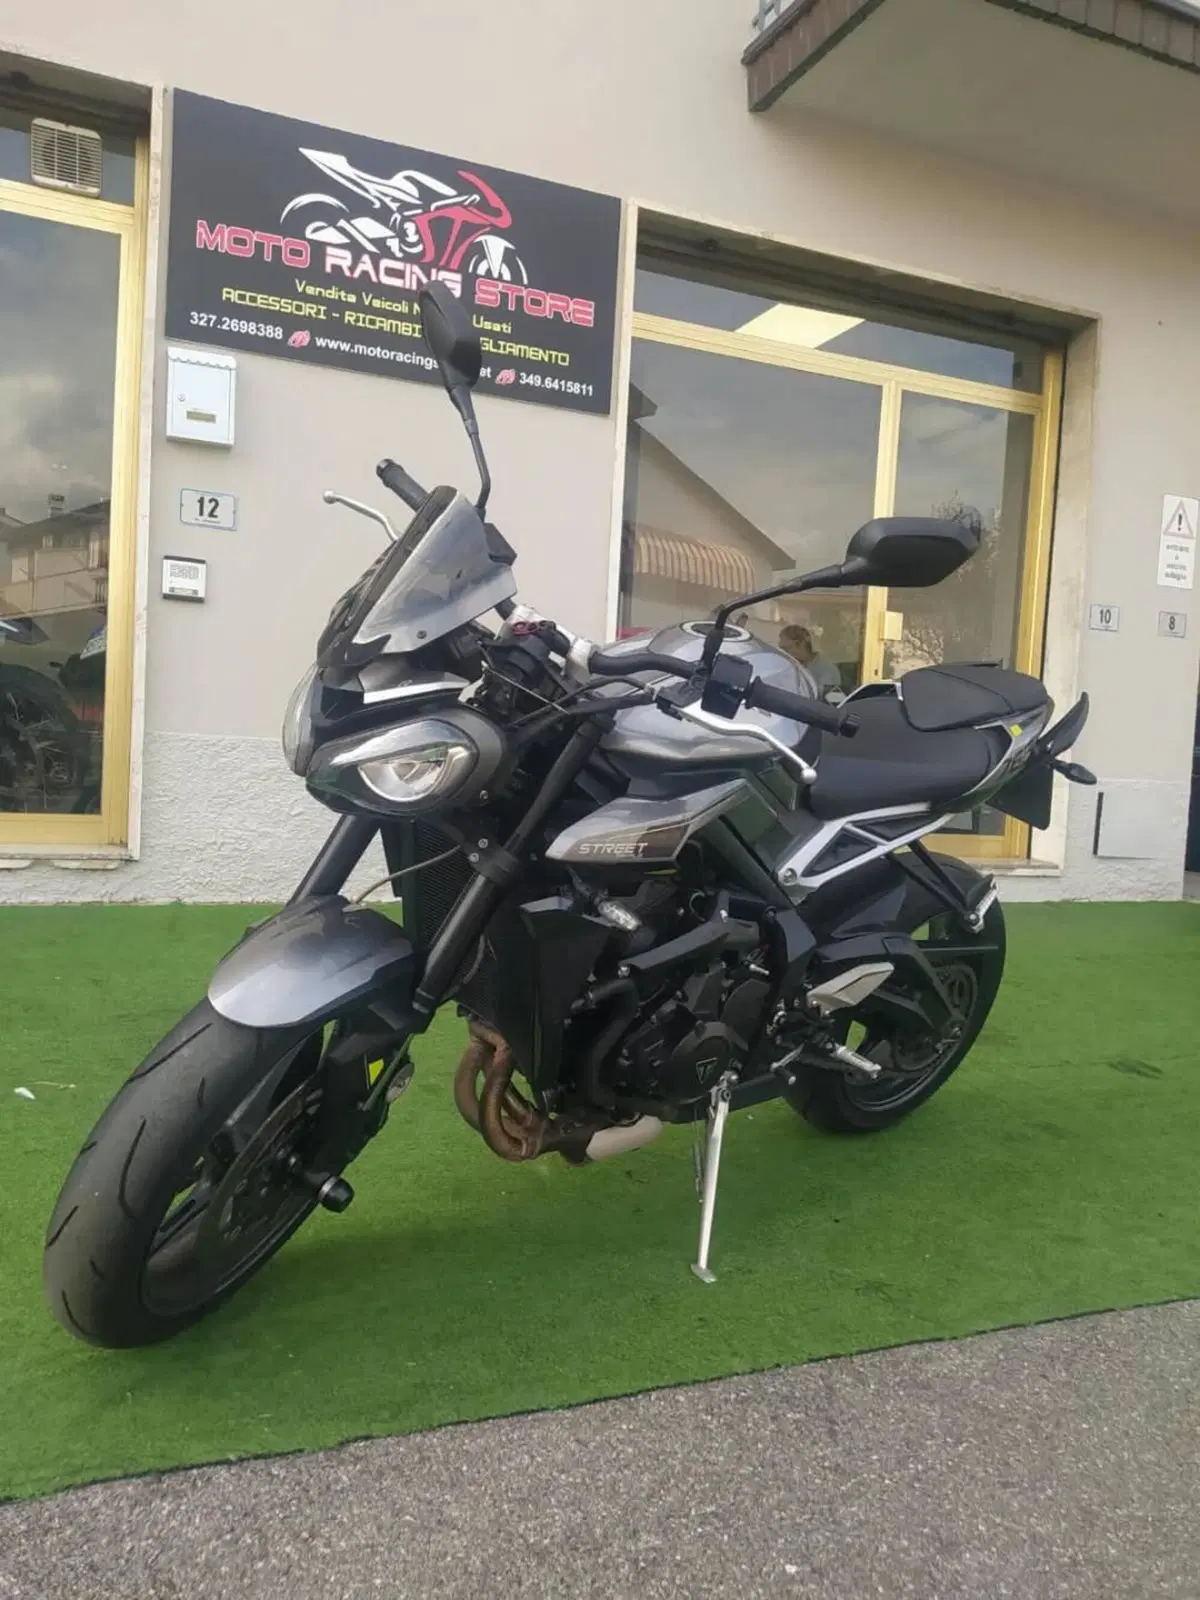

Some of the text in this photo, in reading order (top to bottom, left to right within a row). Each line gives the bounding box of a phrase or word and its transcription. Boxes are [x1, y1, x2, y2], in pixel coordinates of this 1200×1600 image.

[196, 220, 595, 327] MOTO RACING STORE
[295, 278, 356, 303] Vendita
[362, 291, 409, 315] Veicoli
[472, 314, 512, 334] Usati
[222, 287, 327, 319] ACCESSORI
[344, 310, 423, 338] RICAMBI
[479, 337, 570, 367] GLIAMENTO
[190, 311, 283, 340] 327.2698388
[519, 372, 593, 397] 349.6415811
[197, 496, 220, 518] 12
[1099, 608, 1112, 624] 10
[1168, 615, 1176, 631] 8
[578, 842, 648, 855] STREET
